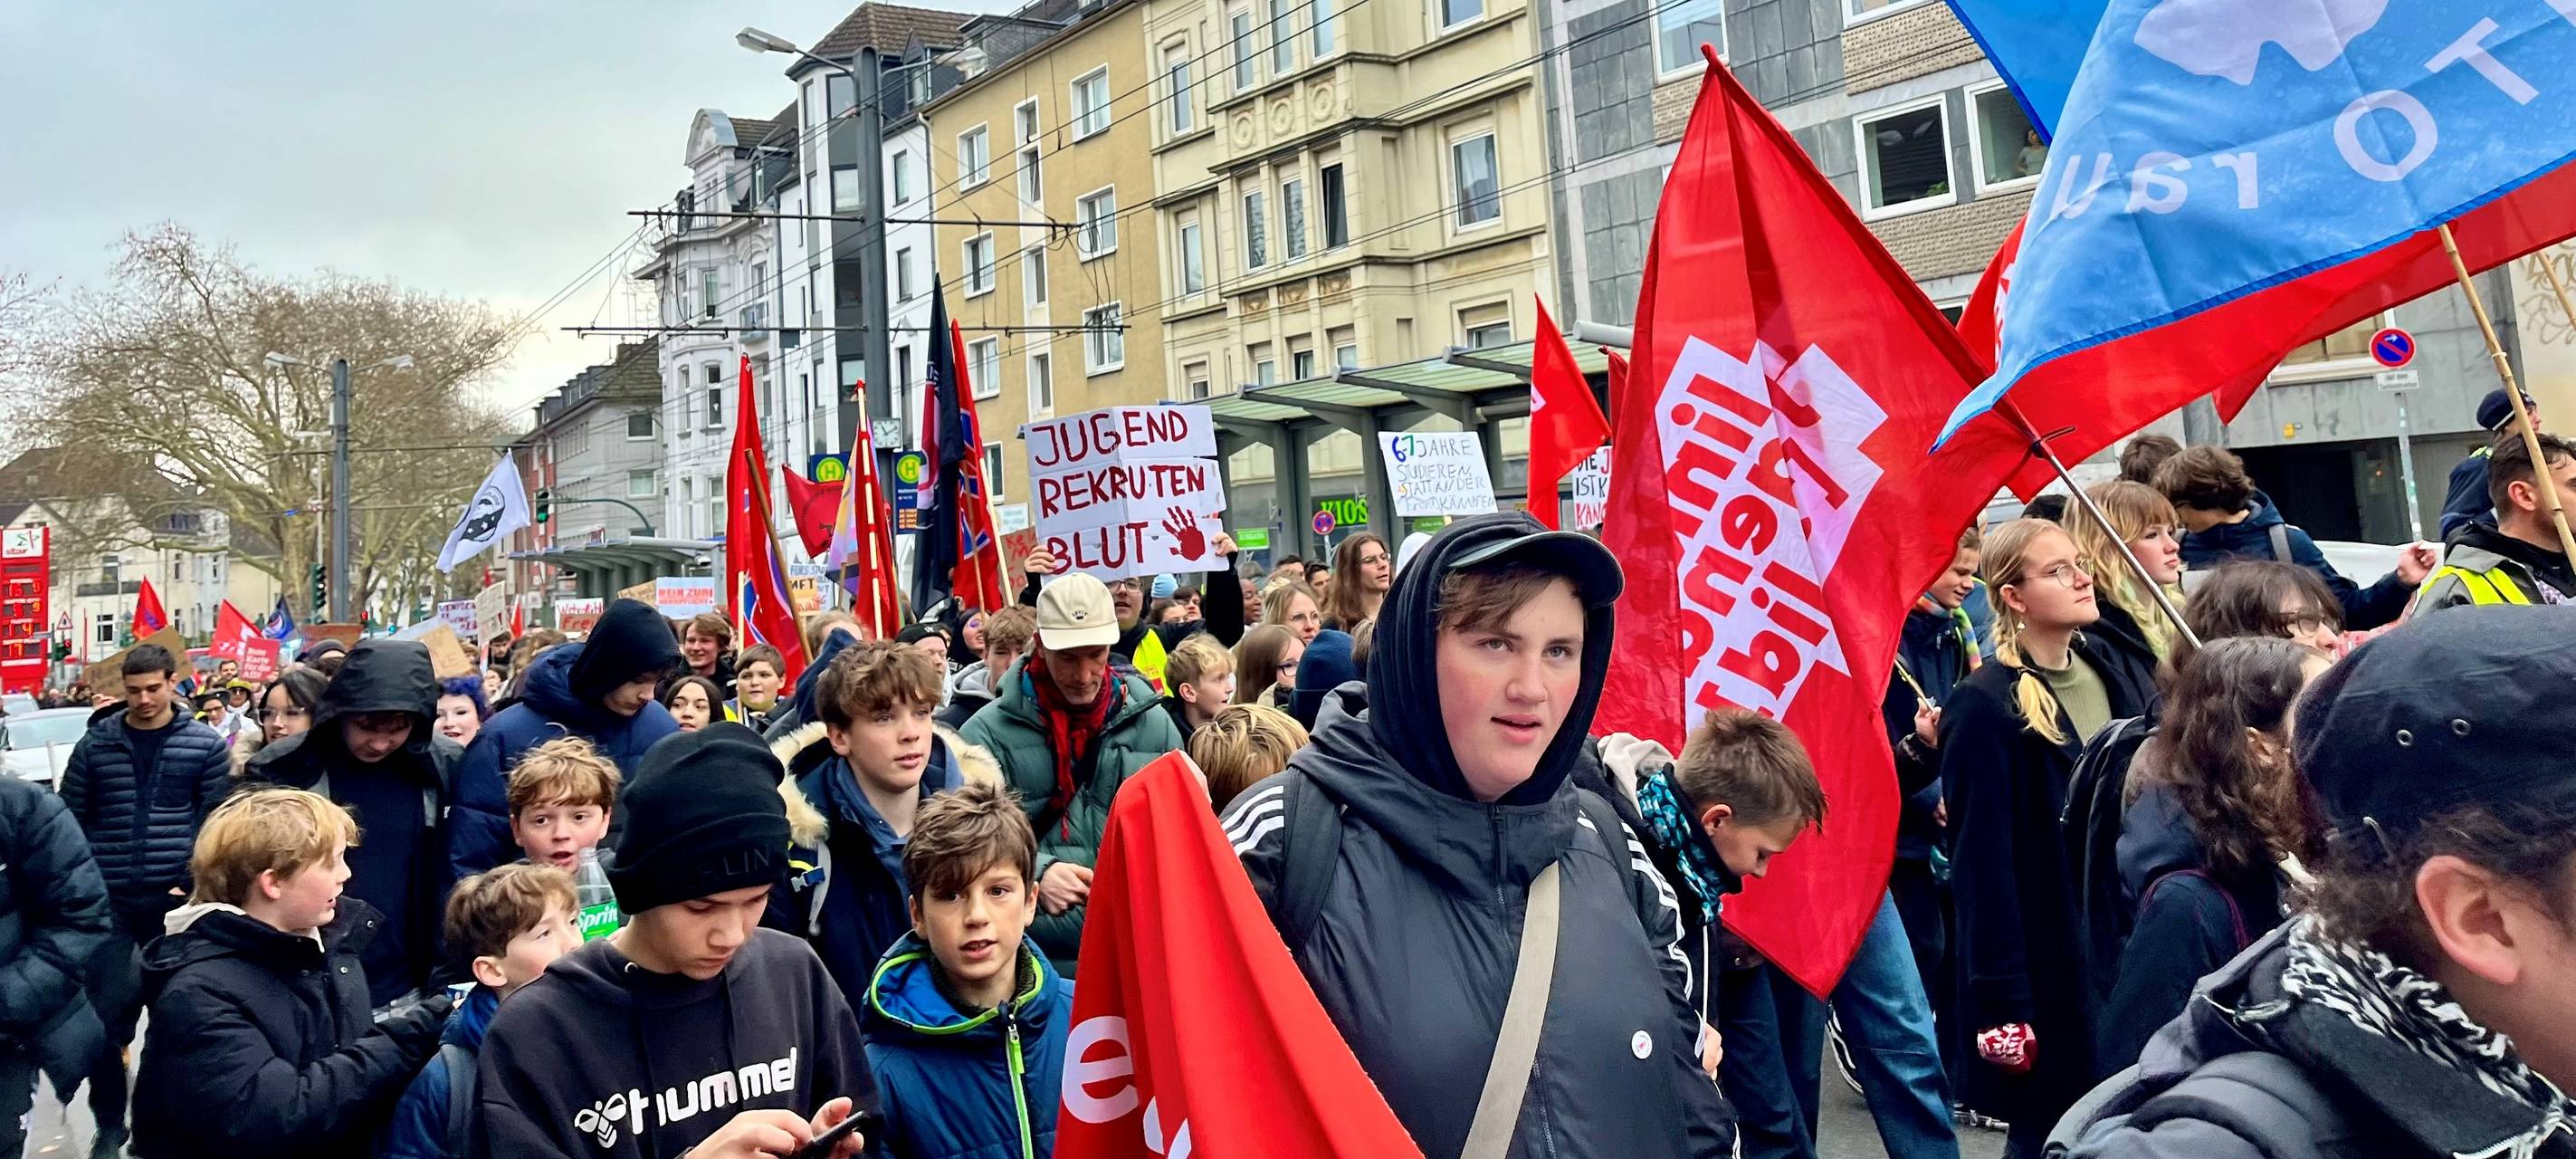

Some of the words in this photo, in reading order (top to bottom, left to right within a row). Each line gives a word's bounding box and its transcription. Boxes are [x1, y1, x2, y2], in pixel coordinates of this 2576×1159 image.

[1032, 410, 1188, 465] JUGEND
[1417, 439, 1472, 457] JAHRE
[1039, 465, 1205, 519] REKRUTEN
[1576, 475, 1596, 496] IST
[1321, 498, 1369, 527] KIOS
[1047, 522, 1148, 574] BLUT
[628, 1046, 797, 1135] hummel
